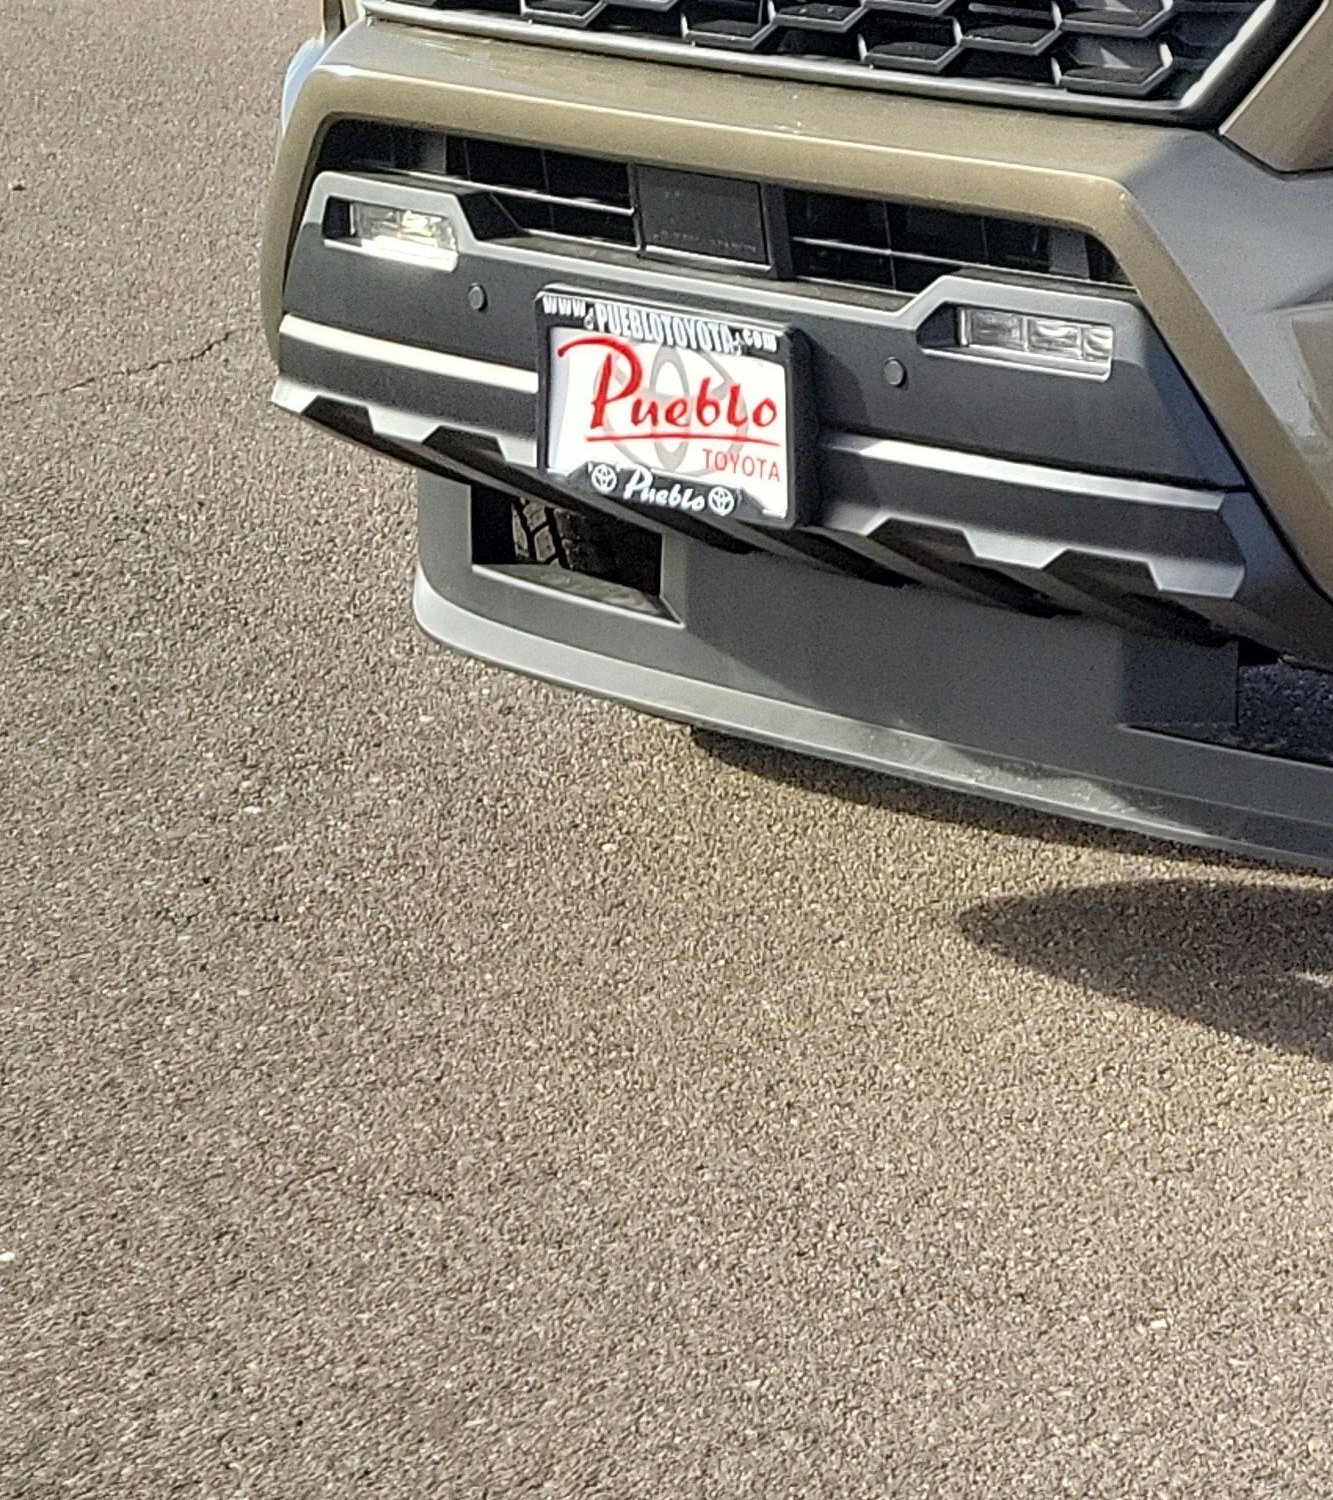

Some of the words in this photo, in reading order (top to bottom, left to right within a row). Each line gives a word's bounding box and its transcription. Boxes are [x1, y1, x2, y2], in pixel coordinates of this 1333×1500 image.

[557, 336, 778, 430] Pueblo
[623, 463, 706, 512] Pueblo
[703, 448, 781, 483] TOYOTA
